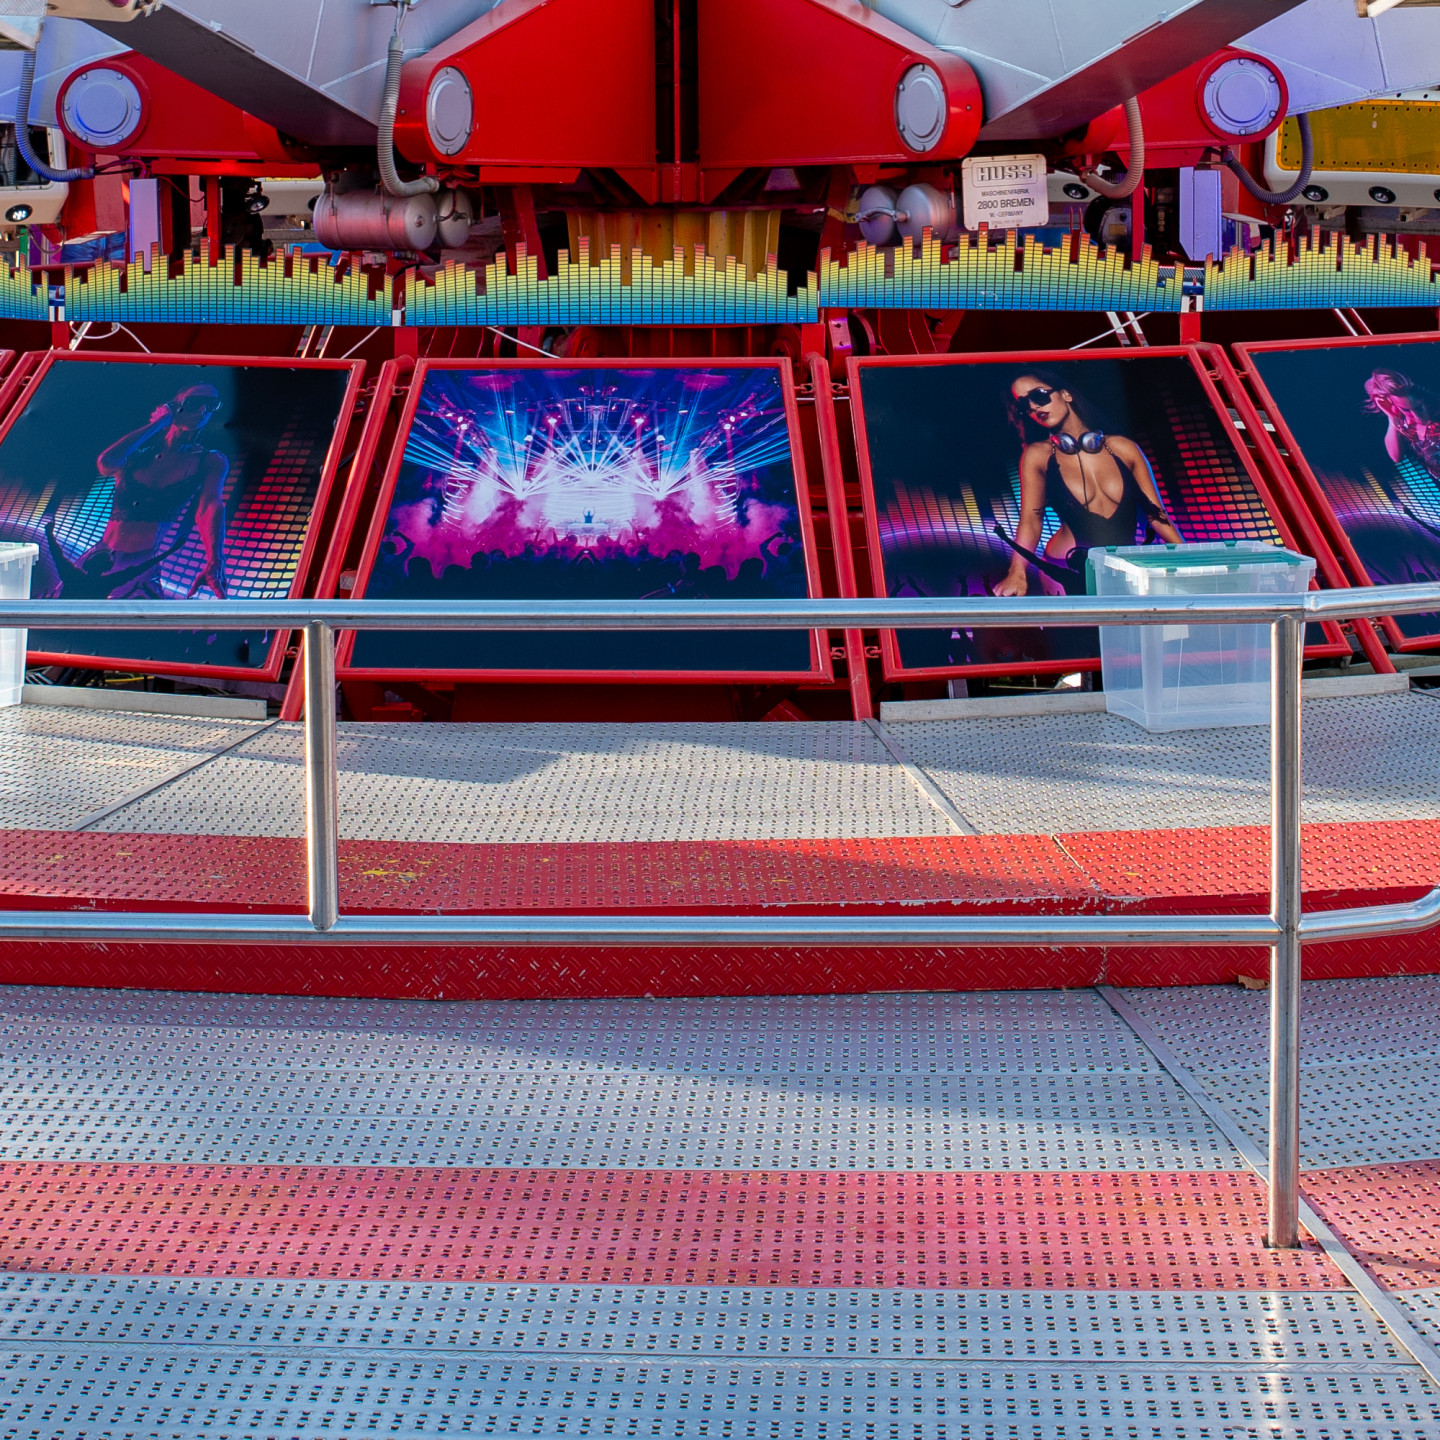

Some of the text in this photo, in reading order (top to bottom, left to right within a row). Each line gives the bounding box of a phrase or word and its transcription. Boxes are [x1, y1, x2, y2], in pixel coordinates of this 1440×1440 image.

[977, 164, 1032, 182] HUSS
[977, 197, 1035, 210] 2800 BREMEN
